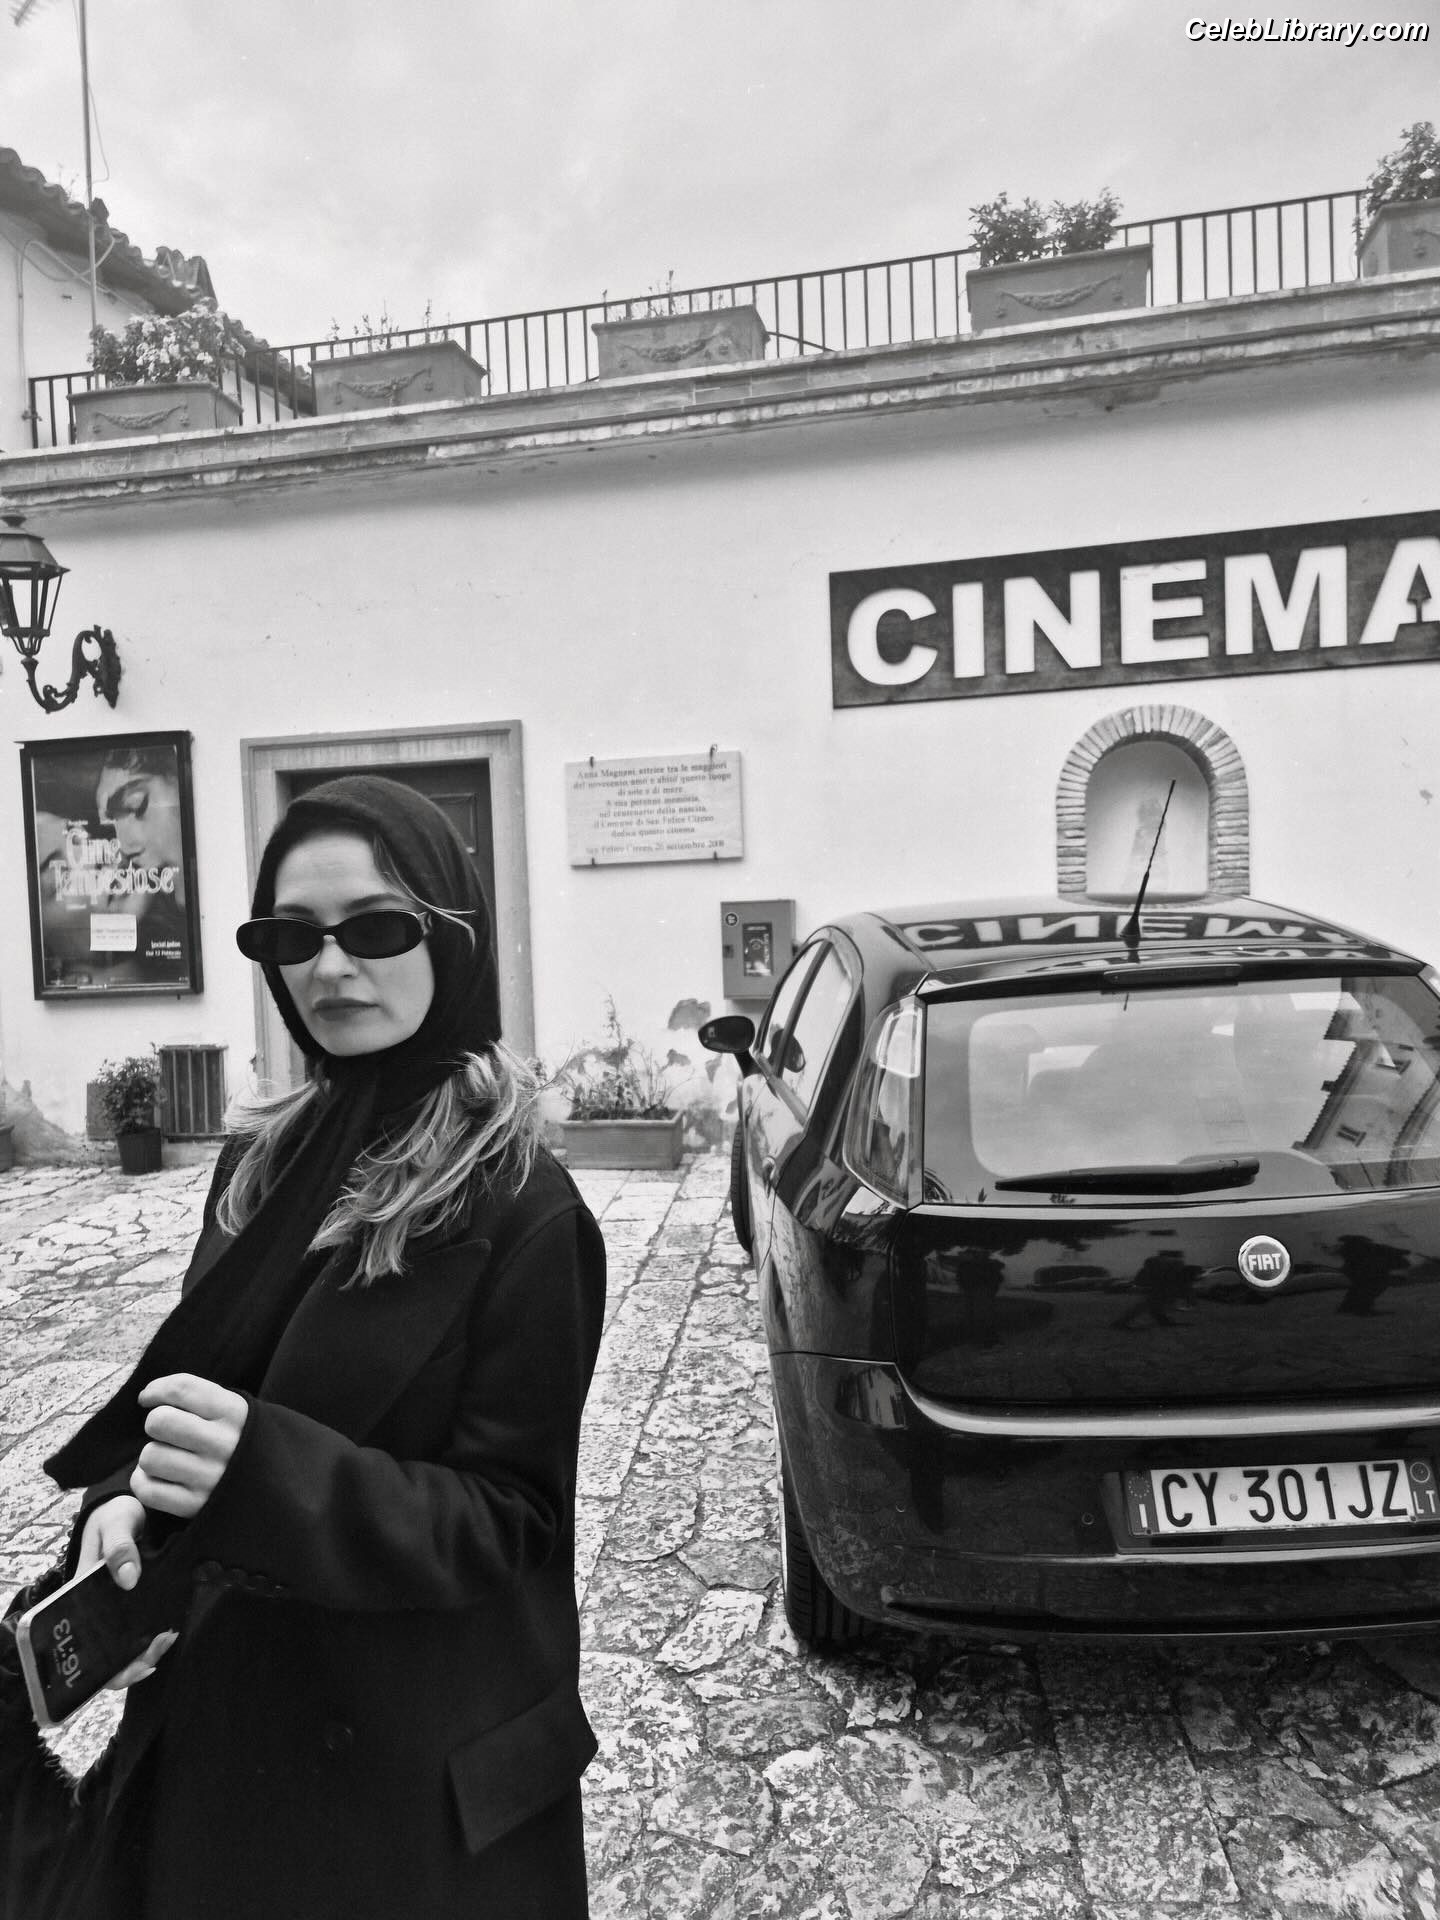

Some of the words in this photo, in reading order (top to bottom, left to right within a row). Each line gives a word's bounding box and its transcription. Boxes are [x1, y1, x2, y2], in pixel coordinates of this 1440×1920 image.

[847, 536, 1440, 686] CINEMA
[601, 768, 636, 779] Magnani
[639, 766, 664, 775] attrice
[667, 765, 678, 773] tra
[681, 764, 689, 772] le
[1248, 1252, 1281, 1271] FIAT
[1161, 1471, 1218, 1528] CY
[1413, 1489, 1438, 1515] LT
[53, 1618, 82, 1689] 16:13
